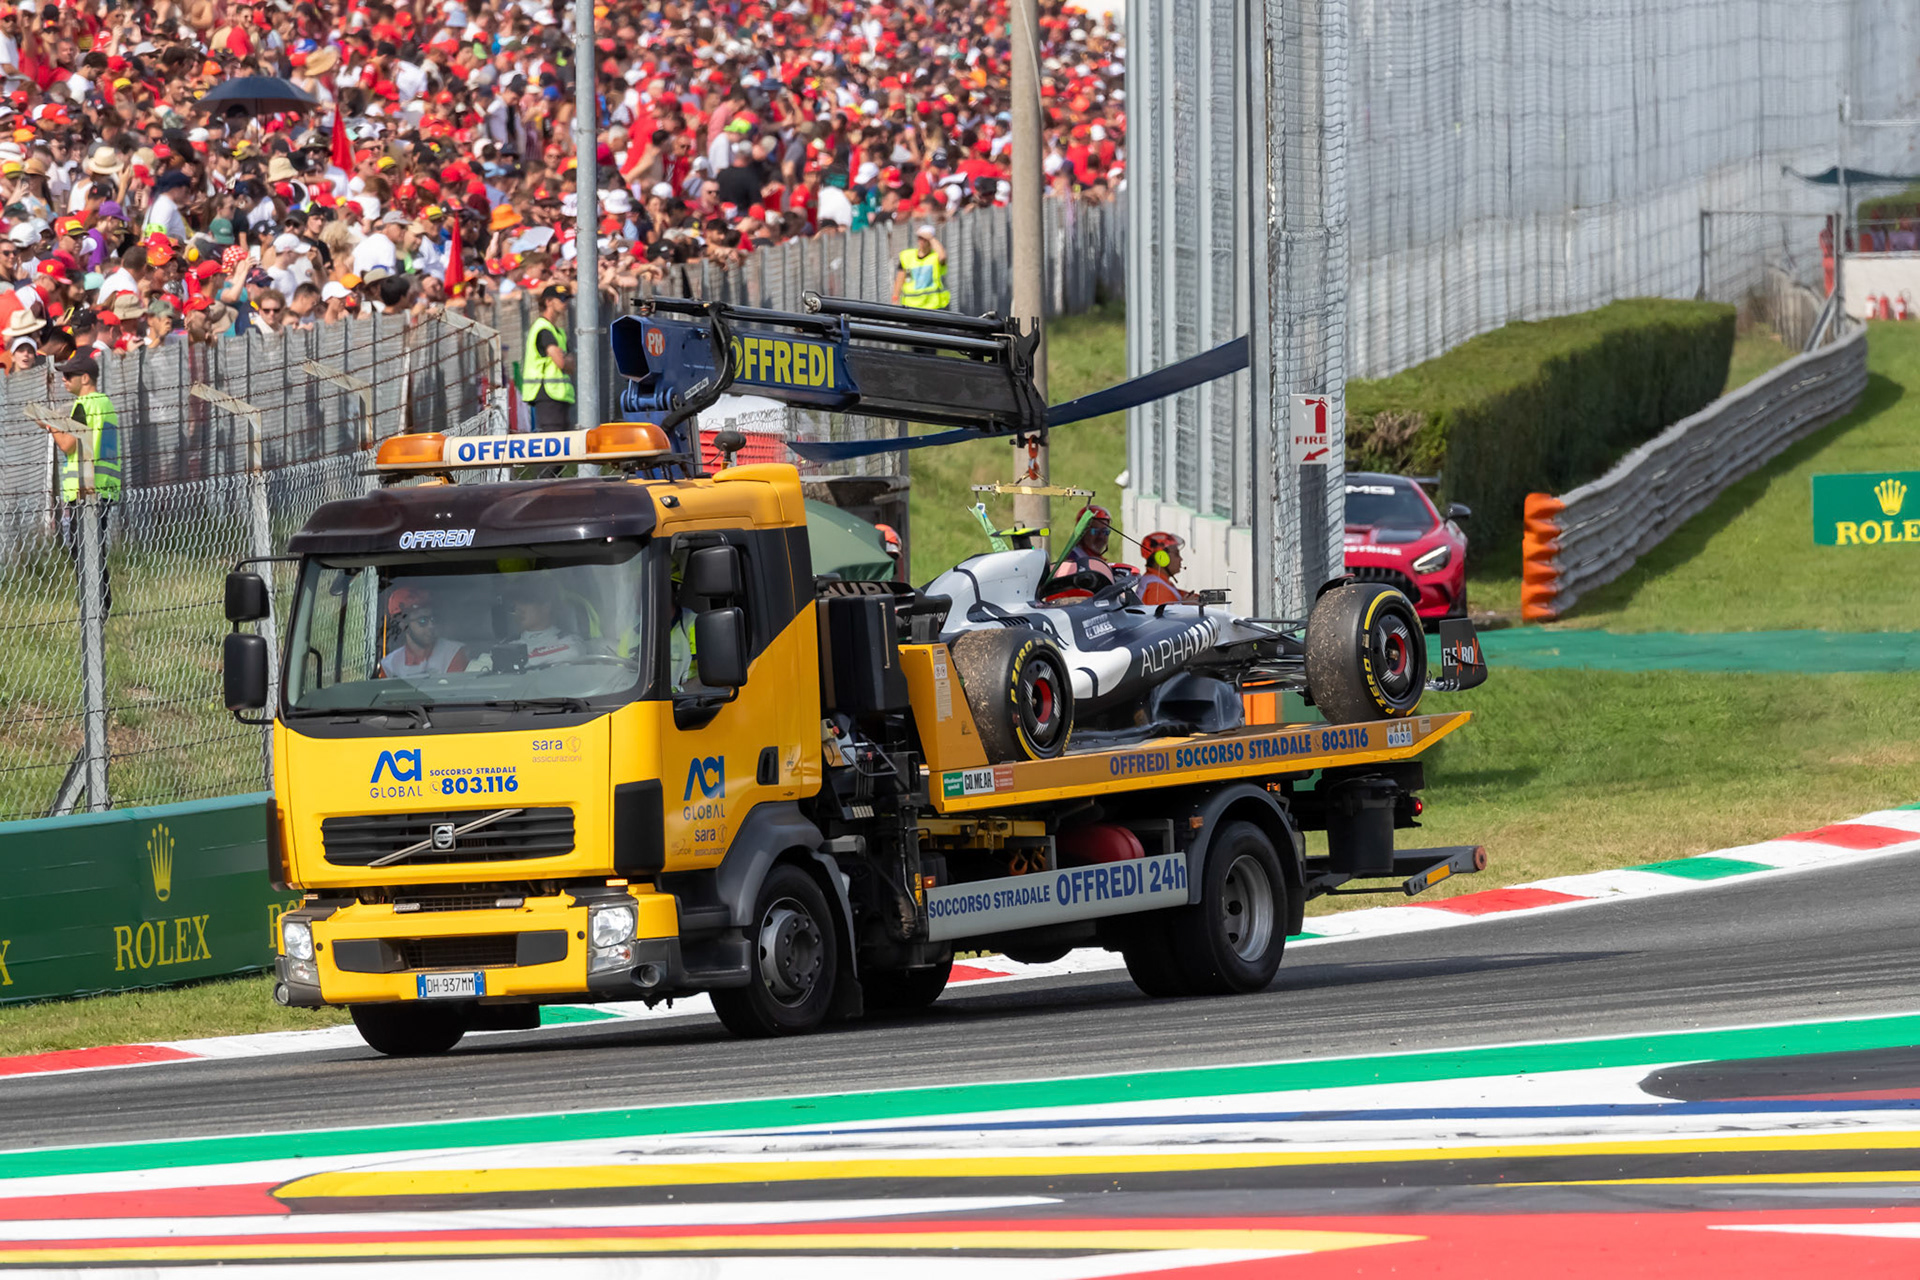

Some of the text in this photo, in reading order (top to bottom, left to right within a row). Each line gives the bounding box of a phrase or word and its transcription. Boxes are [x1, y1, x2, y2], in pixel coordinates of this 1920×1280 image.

[648, 333, 664, 354] PM
[730, 335, 835, 388] OFFREDI
[458, 437, 571, 462] OFFREDI
[1295, 436, 1328, 445] FIRE
[399, 529, 477, 550] OFFREDI
[1835, 519, 1920, 546] ROLE
[1010, 639, 1033, 704] P ZERO
[1363, 658, 1387, 708] ZERO
[1385, 707, 1395, 715] P
[532, 738, 563, 751] sara
[1109, 727, 1369, 776] OFFREDI SOCCORSO STRADALE 803.116
[430, 766, 517, 777] SOCCORSO STRADALE
[370, 785, 423, 799] GLOBAL
[441, 774, 519, 795] 803.116
[683, 803, 726, 820] GLOBAL
[694, 828, 716, 842] sara
[928, 858, 1187, 919] SOCCORSO STRADALE OFFREDI 24h
[113, 914, 212, 972] ROLEX
